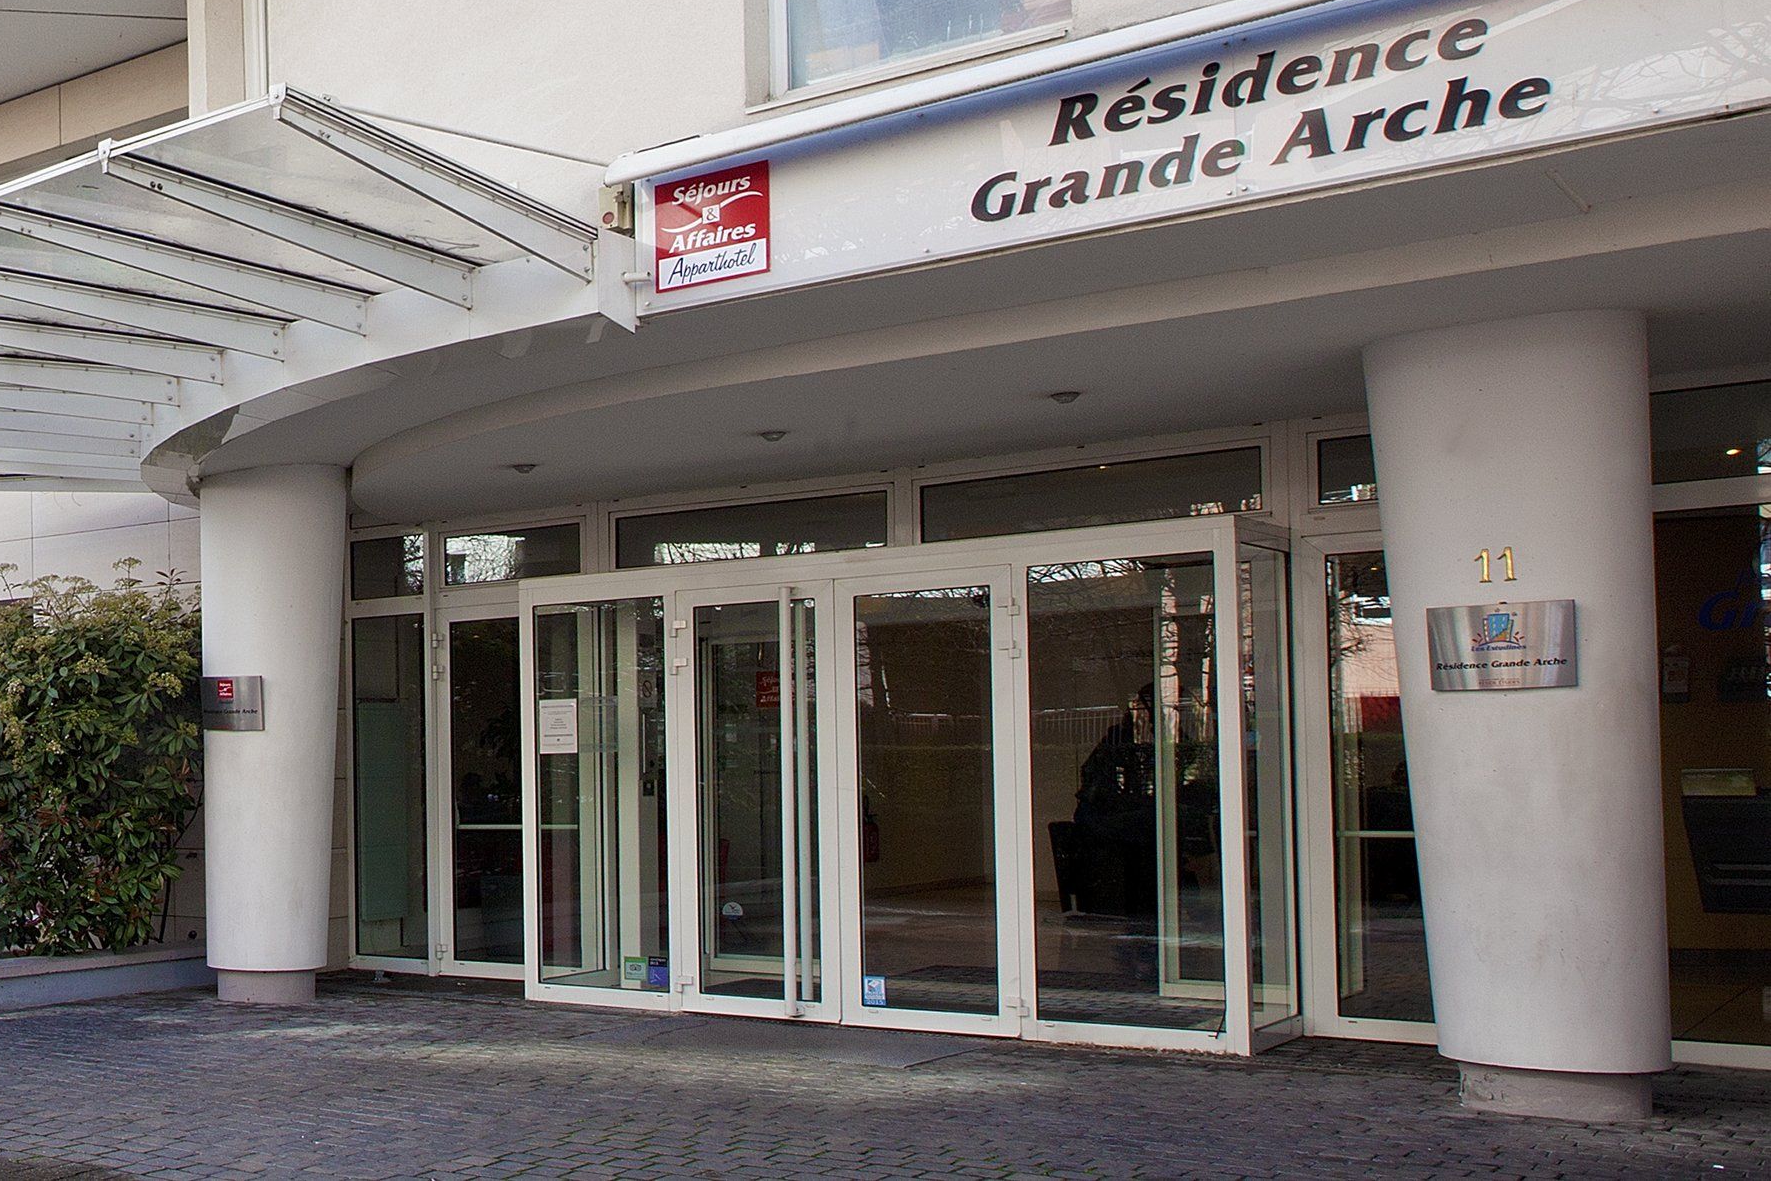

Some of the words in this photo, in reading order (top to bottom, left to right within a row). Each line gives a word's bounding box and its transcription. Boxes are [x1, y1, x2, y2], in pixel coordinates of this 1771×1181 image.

[1048, 17, 1489, 147] Résidence
[970, 133, 1246, 223] Grande
[1270, 74, 1552, 166] Arche
[672, 176, 751, 206] Séjours
[706, 208, 718, 220] &
[668, 222, 756, 254] Affaires
[668, 242, 757, 285] Apparthotel
[1474, 546, 1518, 583] 11
[1436, 660, 1488, 671] Résidence
[1491, 659, 1531, 668] Grande
[1533, 657, 1568, 667] Arche
